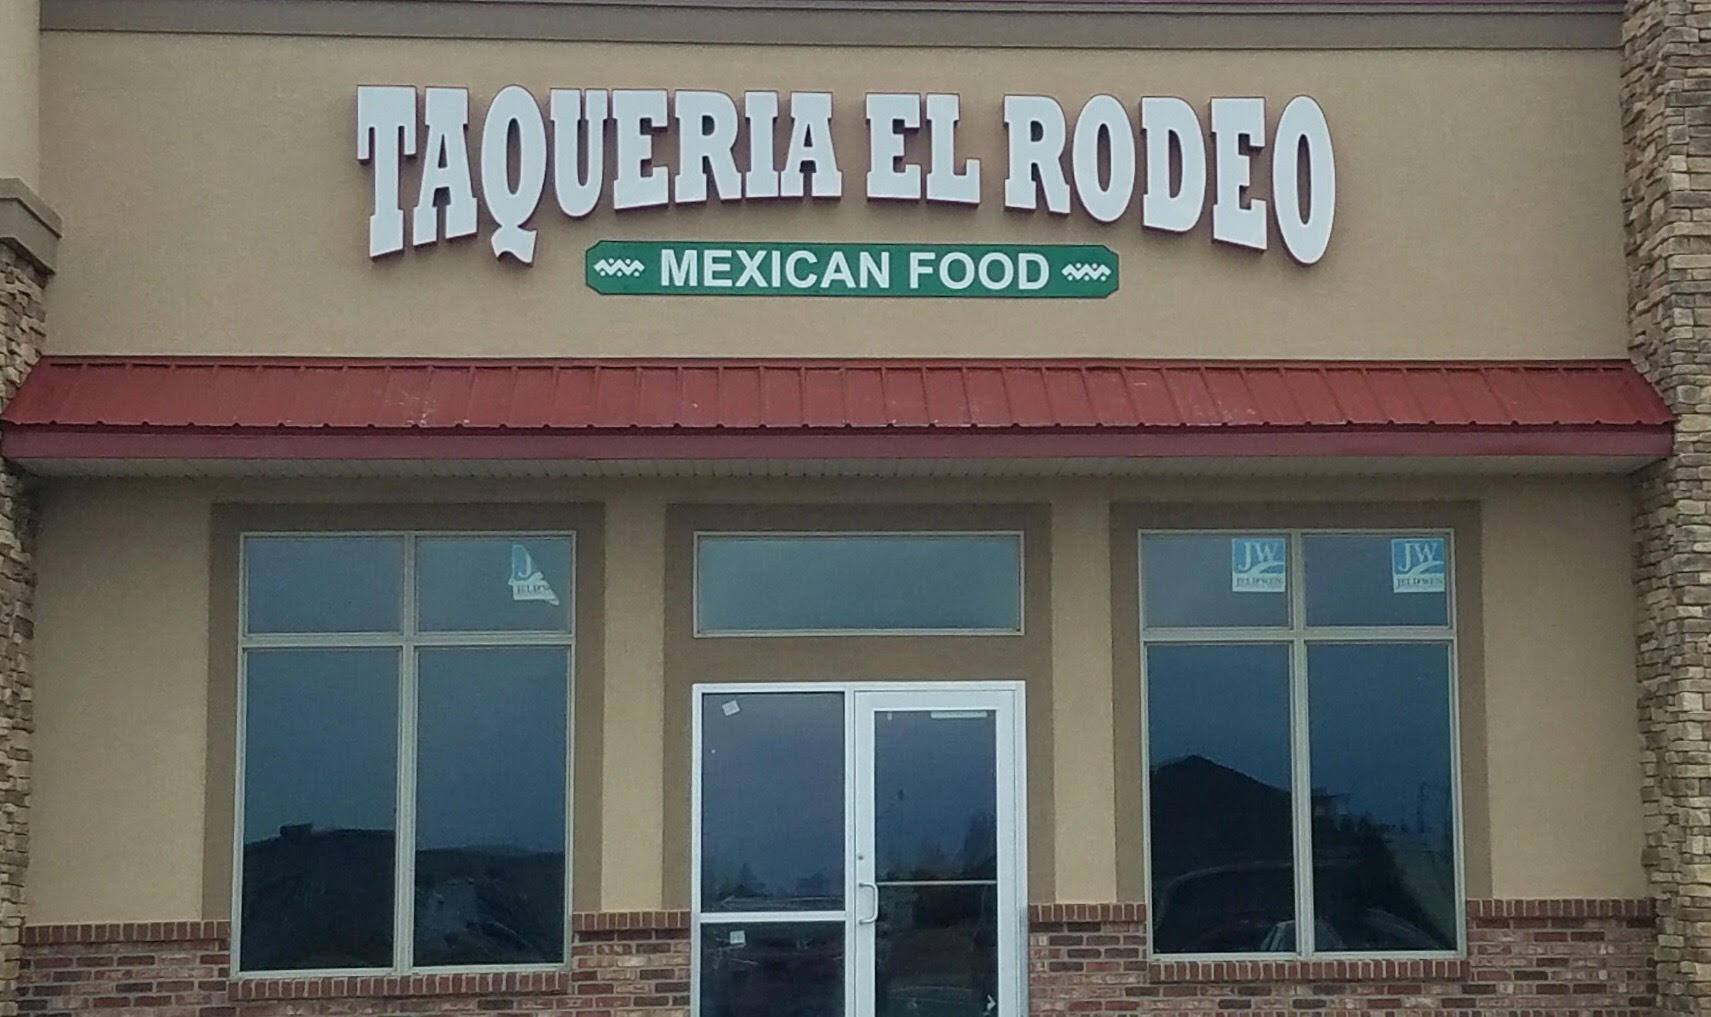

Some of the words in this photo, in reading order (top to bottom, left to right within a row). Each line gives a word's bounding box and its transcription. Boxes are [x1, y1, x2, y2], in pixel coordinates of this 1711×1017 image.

[357, 84, 842, 264] TAQUERIA
[866, 92, 981, 204] EL
[1004, 93, 1336, 265] RODEO
[660, 249, 891, 289] MEXICAN
[909, 252, 1050, 290] FOOD
[1238, 542, 1280, 571] JW
[1398, 542, 1438, 572] JW
